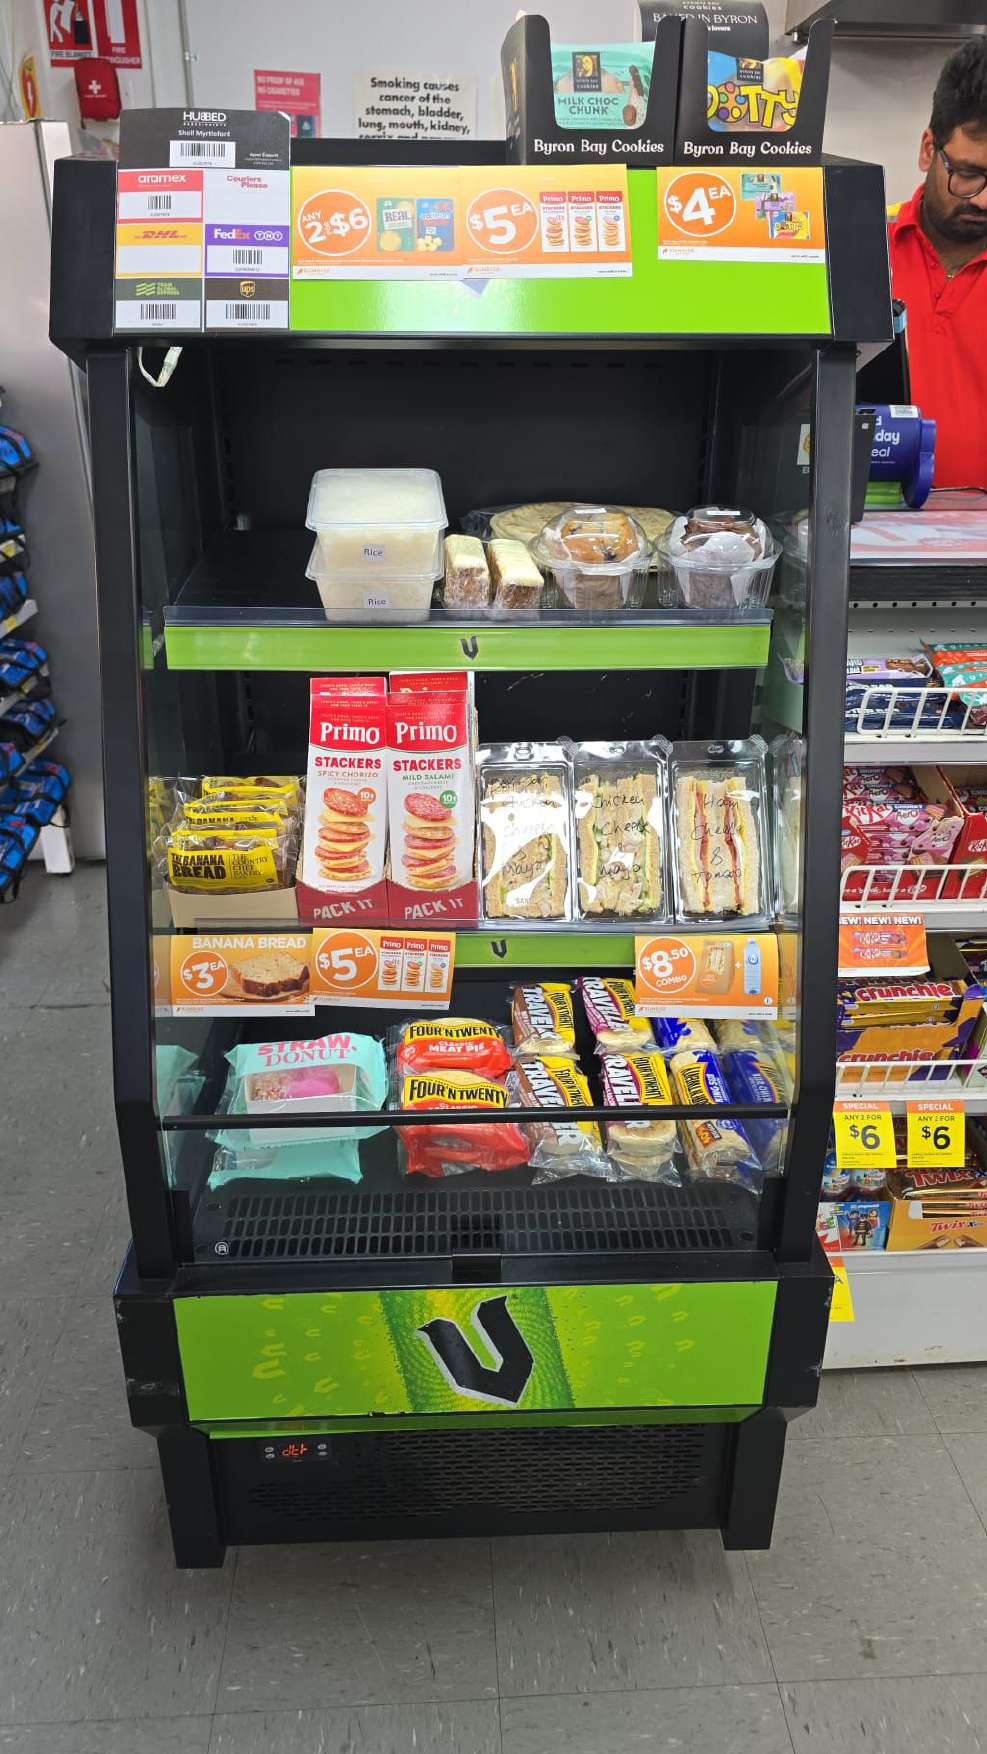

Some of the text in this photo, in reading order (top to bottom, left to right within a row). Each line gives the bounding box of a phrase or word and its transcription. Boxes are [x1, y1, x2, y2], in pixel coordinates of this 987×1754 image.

[713, 15, 758, 24] BYRON
[370, 77, 460, 92] Smoking causes
[379, 93, 451, 104] cancer of the
[587, 97, 619, 105] CHOC
[365, 105, 464, 121] stomach, bladder,
[569, 106, 609, 115] CHUNK
[358, 117, 471, 135] lung, mouth, kidney,
[534, 139, 664, 155] Byron Bay Cookies
[683, 141, 812, 157] Byron Bay Cookies
[138, 175, 187, 183] aramex
[667, 186, 732, 226] $4 EA
[302, 210, 323, 222] ANY
[469, 205, 516, 245] $5
[510, 202, 535, 217] EA
[304, 206, 369, 245] 2 $6
[213, 228, 249, 240] FedEx
[240, 286, 255, 296] ups
[363, 548, 383, 557] Rice
[367, 598, 387, 606] Rice
[320, 721, 380, 745] Primo
[395, 720, 457, 745] Primo
[314, 756, 382, 769] STACKERS
[393, 758, 462, 772] STACKERS
[402, 773, 422, 781] MILD
[703, 794, 739, 809] Ham
[183, 855, 225, 866] BANANA
[172, 864, 227, 880] BREAD
[313, 898, 373, 920] PACK IT
[404, 898, 465, 920] PACK IT
[864, 916, 890, 924] NEW!
[894, 916, 922, 924] NEW!
[192, 938, 306, 948] BANANA BREAD
[319, 946, 375, 981] $5 EA
[182, 960, 224, 989] $3 EA
[655, 975, 688, 987] COMBO
[855, 982, 954, 1001] crunchie
[466, 1042, 485, 1052] PIE
[265, 1048, 348, 1067] DONUT
[849, 1124, 881, 1150] $6
[921, 1125, 951, 1150] $6
[905, 1167, 973, 1188] Twix
[930, 1221, 965, 1232] Twix
